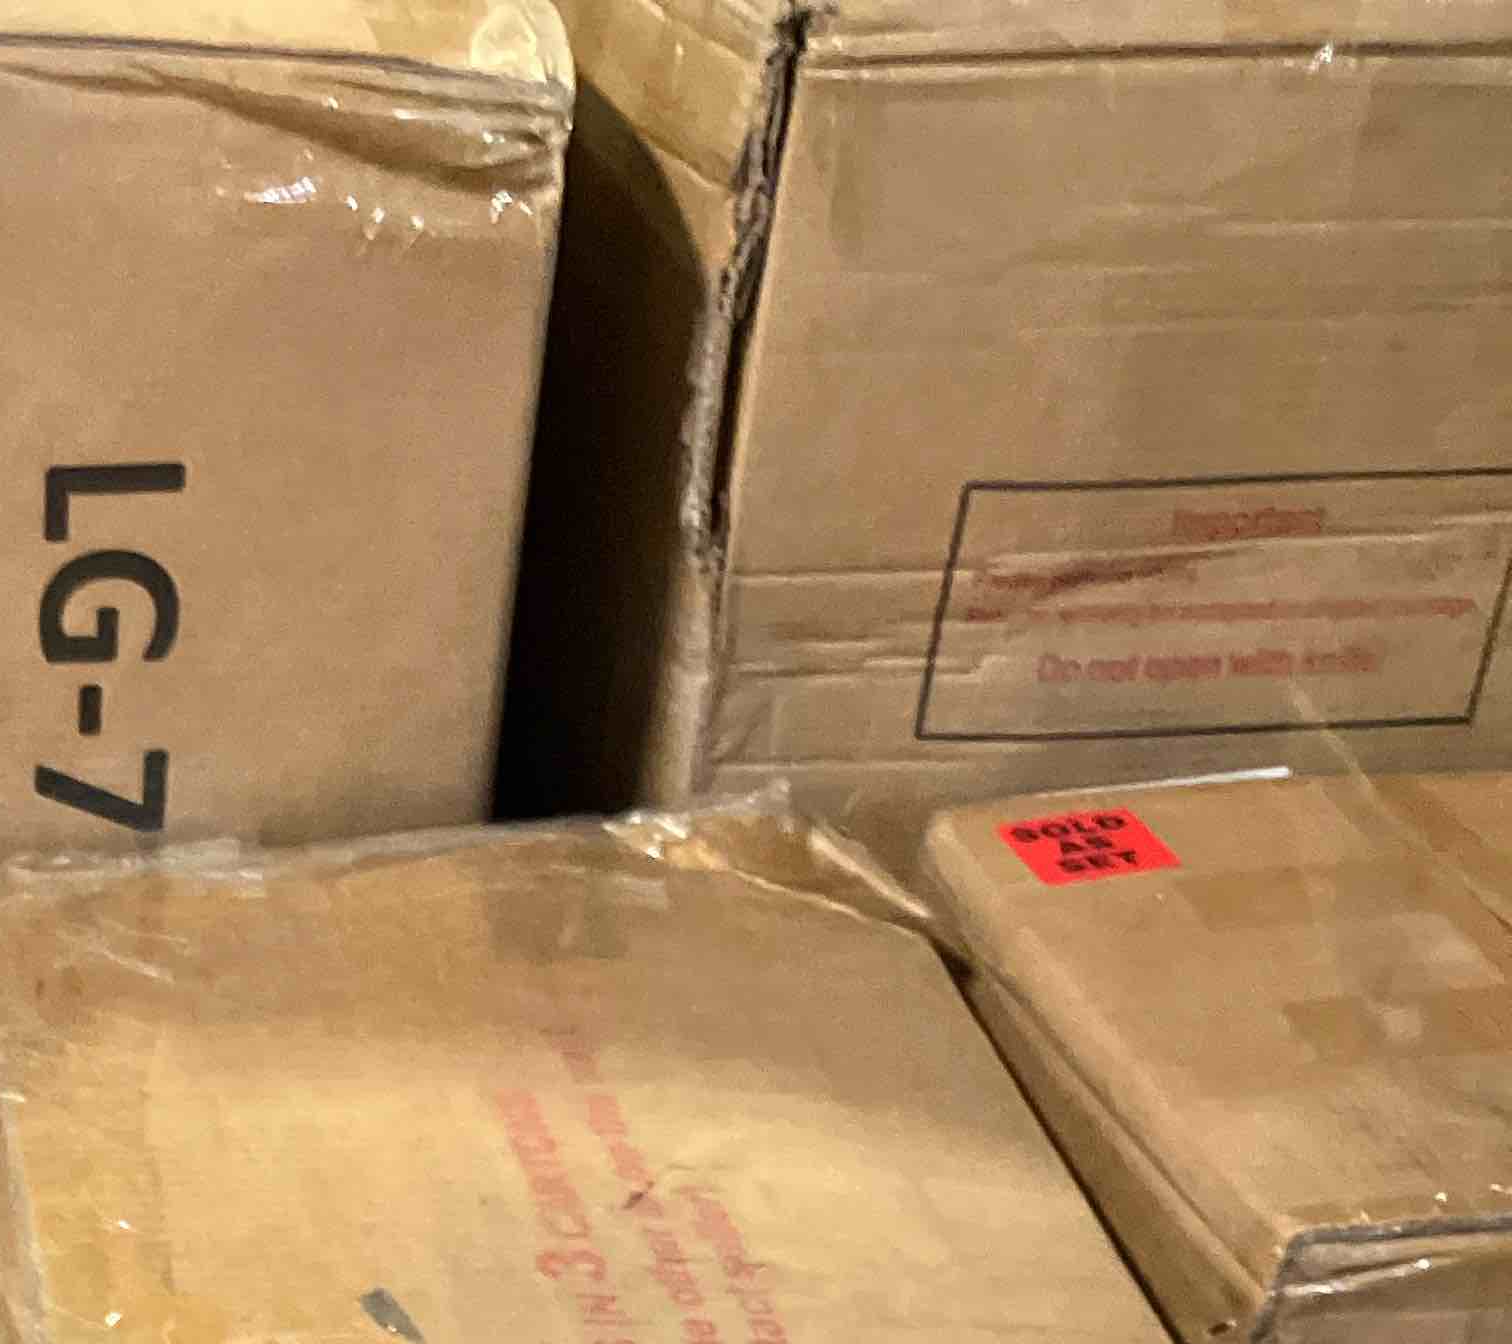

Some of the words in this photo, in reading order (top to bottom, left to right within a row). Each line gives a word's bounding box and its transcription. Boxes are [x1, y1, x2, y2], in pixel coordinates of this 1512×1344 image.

[1010, 814, 1124, 843] SOLD
[1059, 834, 1113, 855] AS
[1058, 849, 1138, 874] SET
[536, 1248, 607, 1281] 3
[576, 1293, 632, 1331] IN
